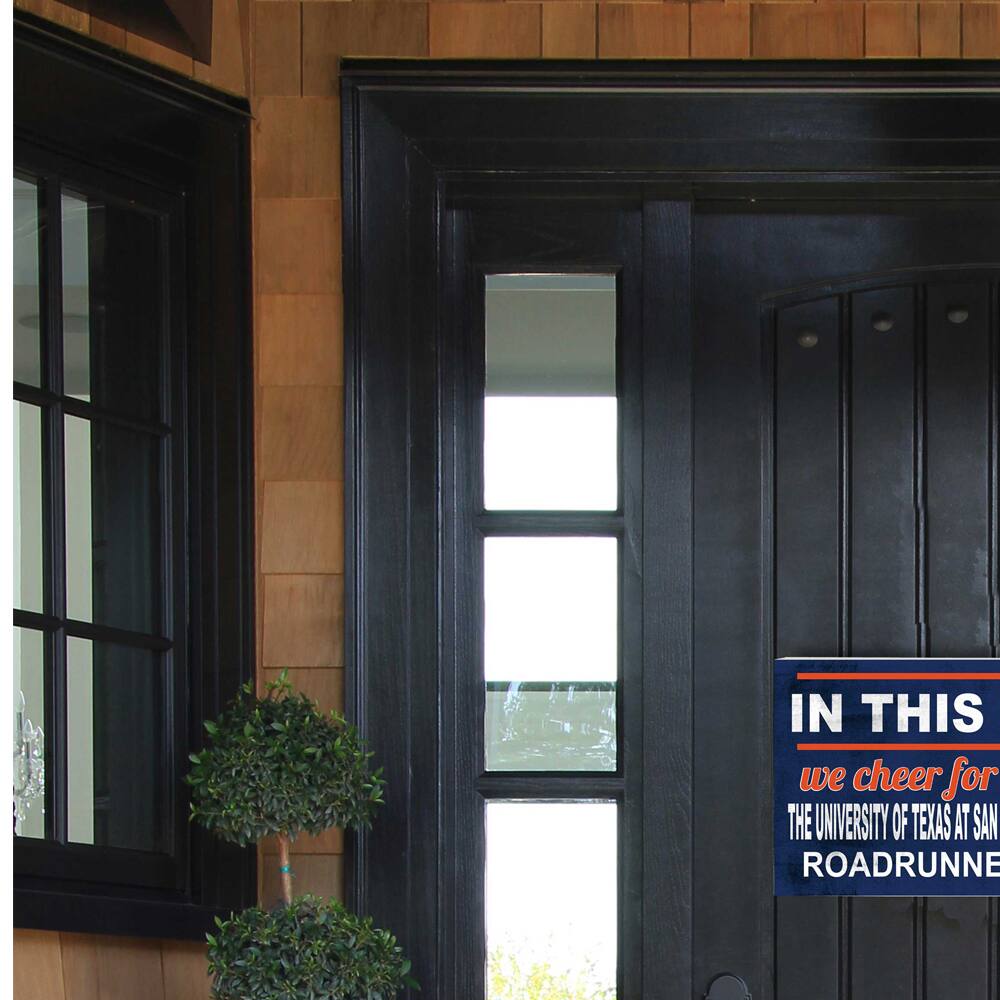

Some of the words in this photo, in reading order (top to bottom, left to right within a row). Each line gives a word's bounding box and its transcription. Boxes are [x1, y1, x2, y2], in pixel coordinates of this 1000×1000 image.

[791, 693, 842, 733] IN
[861, 693, 983, 733] THIS
[799, 766, 848, 791] we
[853, 758, 943, 791] cheer
[941, 756, 999, 801] for
[788, 803, 813, 840] THE
[815, 803, 890, 840] UNIVERSITY
[893, 803, 908, 840] OF
[910, 803, 951, 840] TEXAS
[954, 803, 970, 840] AT
[973, 803, 999, 840] SAN
